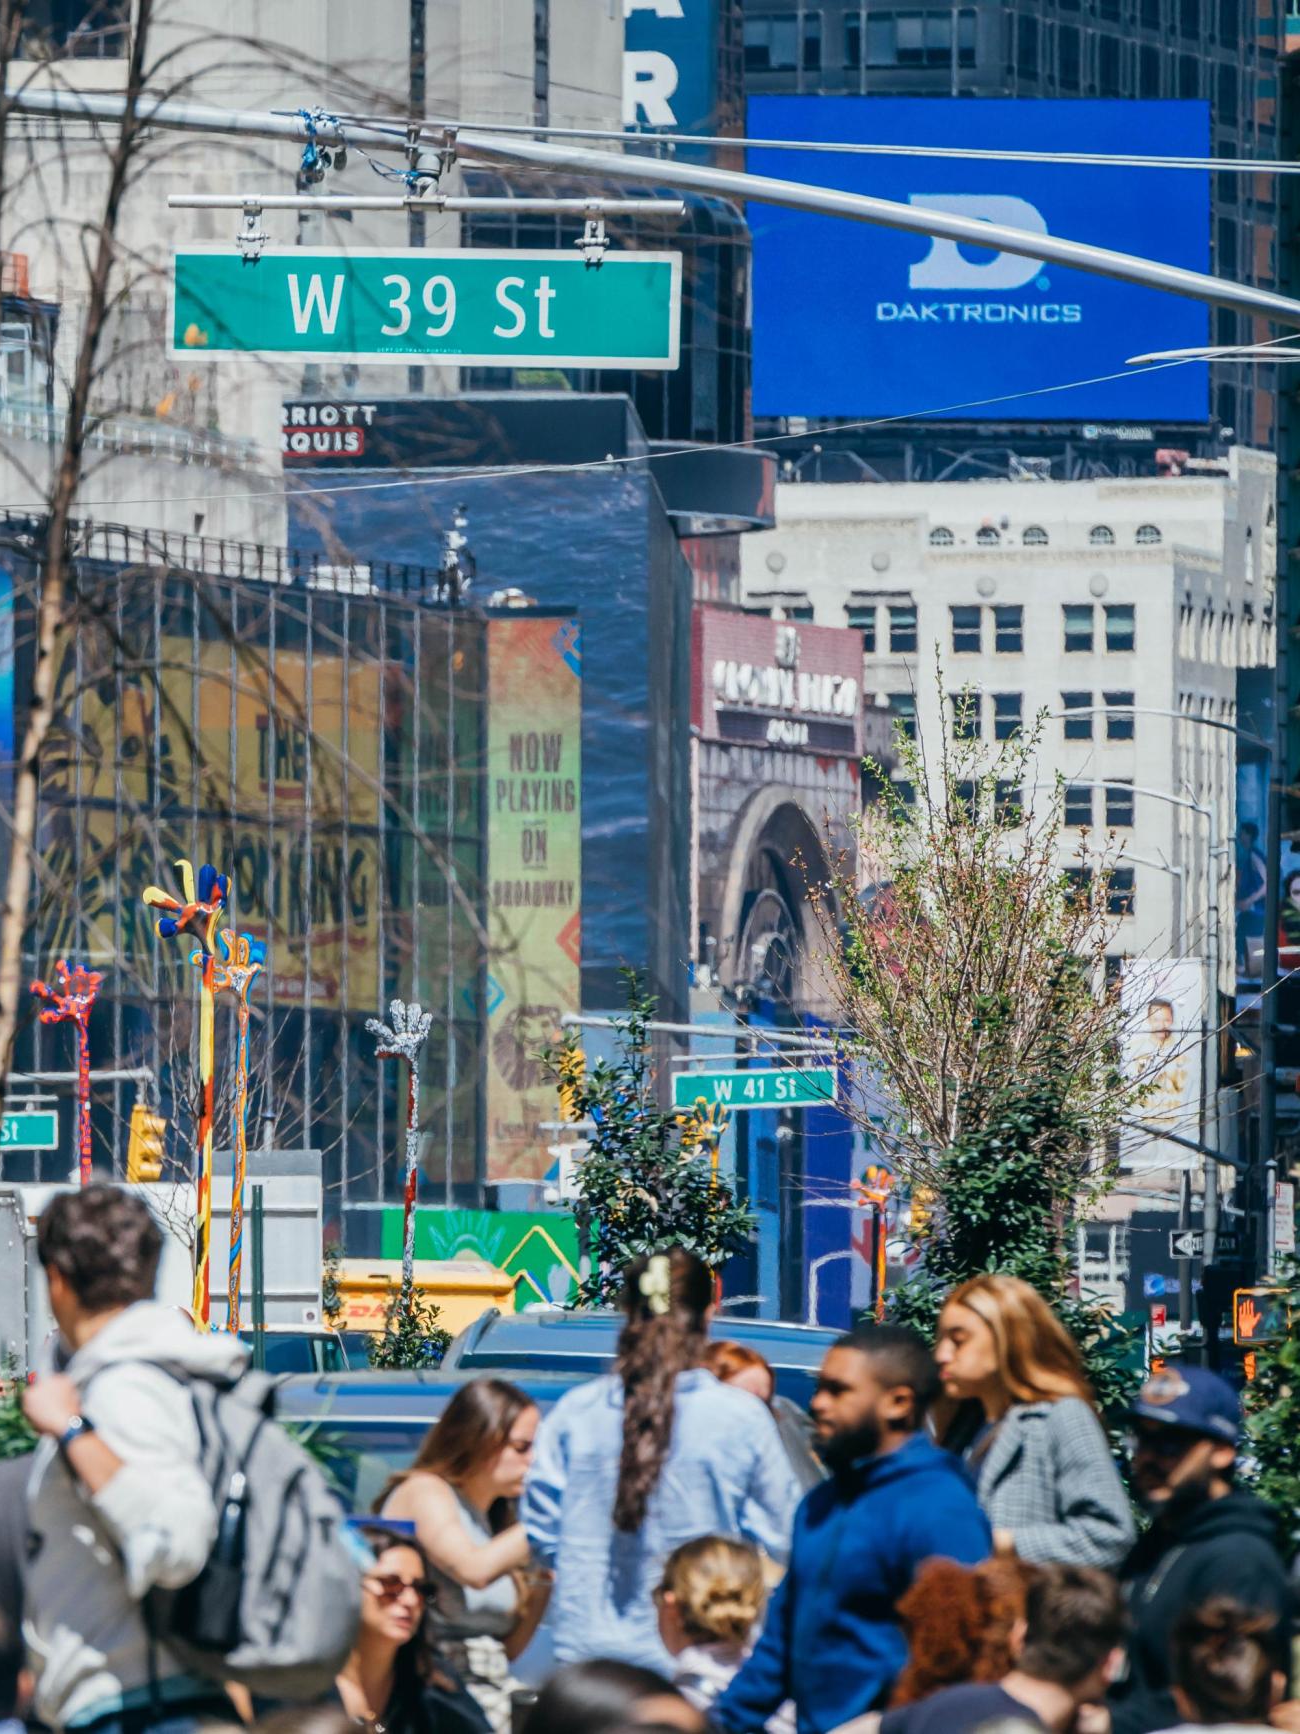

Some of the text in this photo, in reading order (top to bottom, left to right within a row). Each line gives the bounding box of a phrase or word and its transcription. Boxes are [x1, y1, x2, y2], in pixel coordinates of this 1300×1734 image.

[287, 273, 557, 339] W 39 St
[876, 302, 1082, 323] DAKTRONICS
[509, 731, 563, 773] NOW
[495, 778, 576, 812] PLAYING
[522, 829, 547, 864] ON
[493, 880, 575, 907] BROADWAY
[713, 1076, 797, 1101] W 41 St
